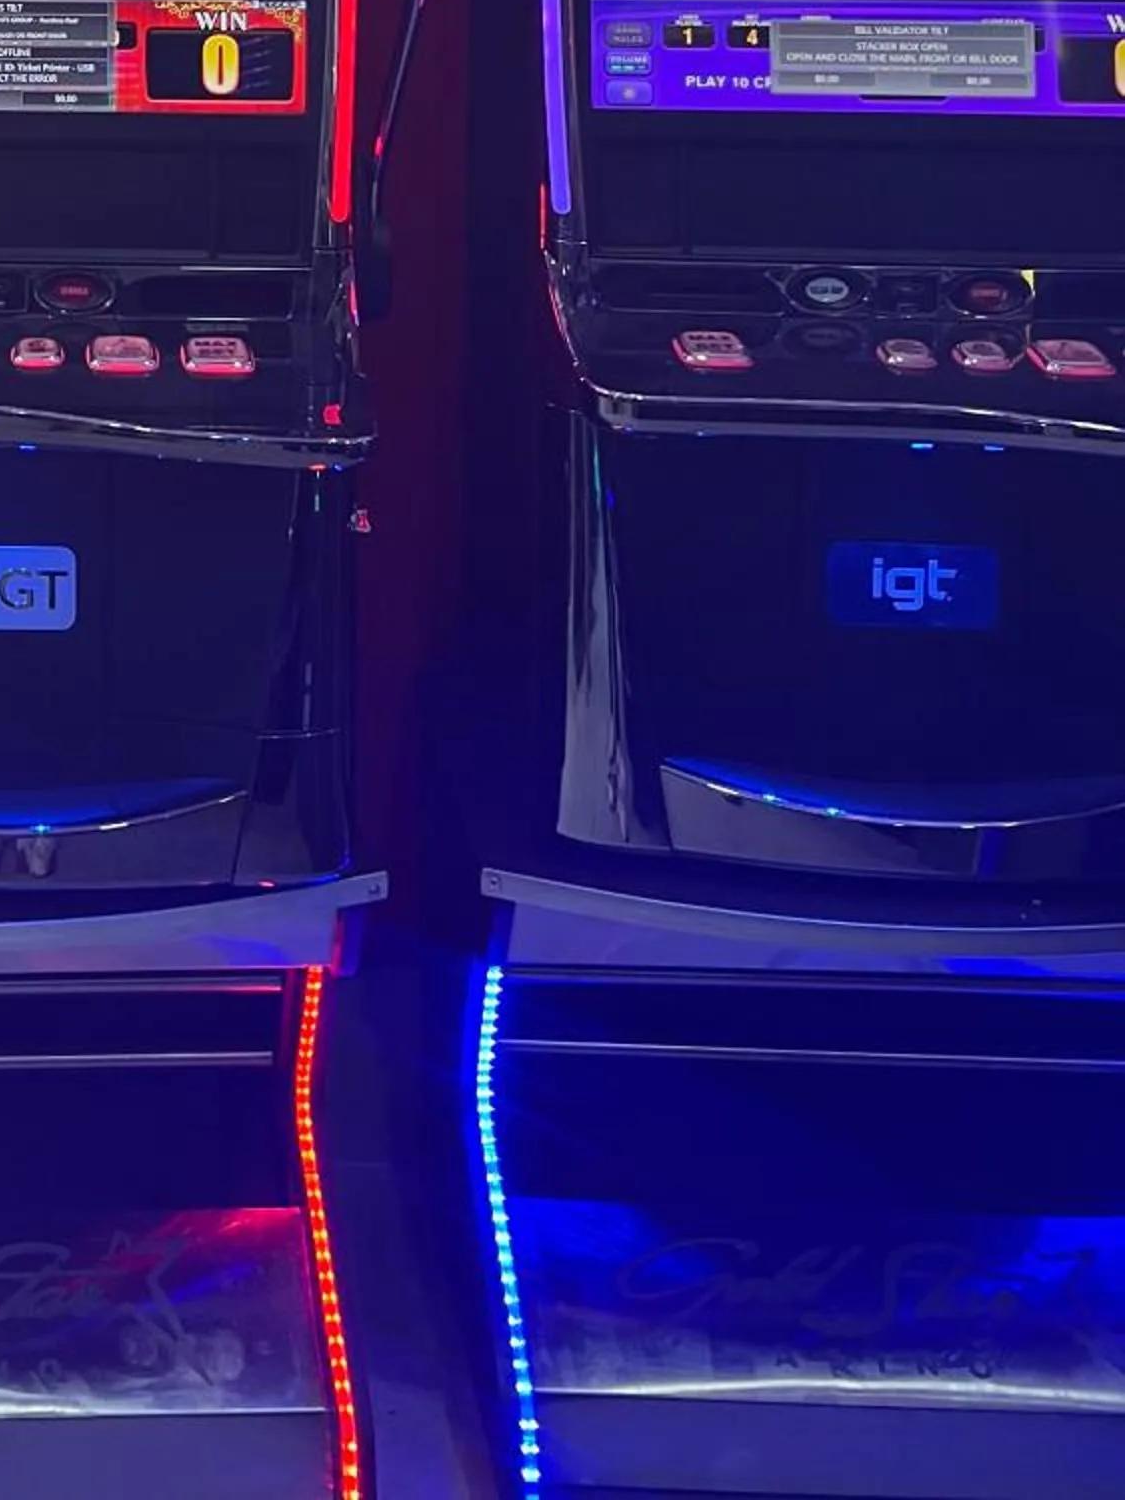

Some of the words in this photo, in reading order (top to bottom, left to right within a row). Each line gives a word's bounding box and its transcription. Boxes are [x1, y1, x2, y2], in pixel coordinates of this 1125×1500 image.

[195, 11, 248, 31] WIN
[682, 28, 693, 46] 1
[745, 28, 759, 46] 4
[202, 33, 240, 95] 0
[684, 75, 726, 88] PLAY
[872, 557, 958, 612] igt
